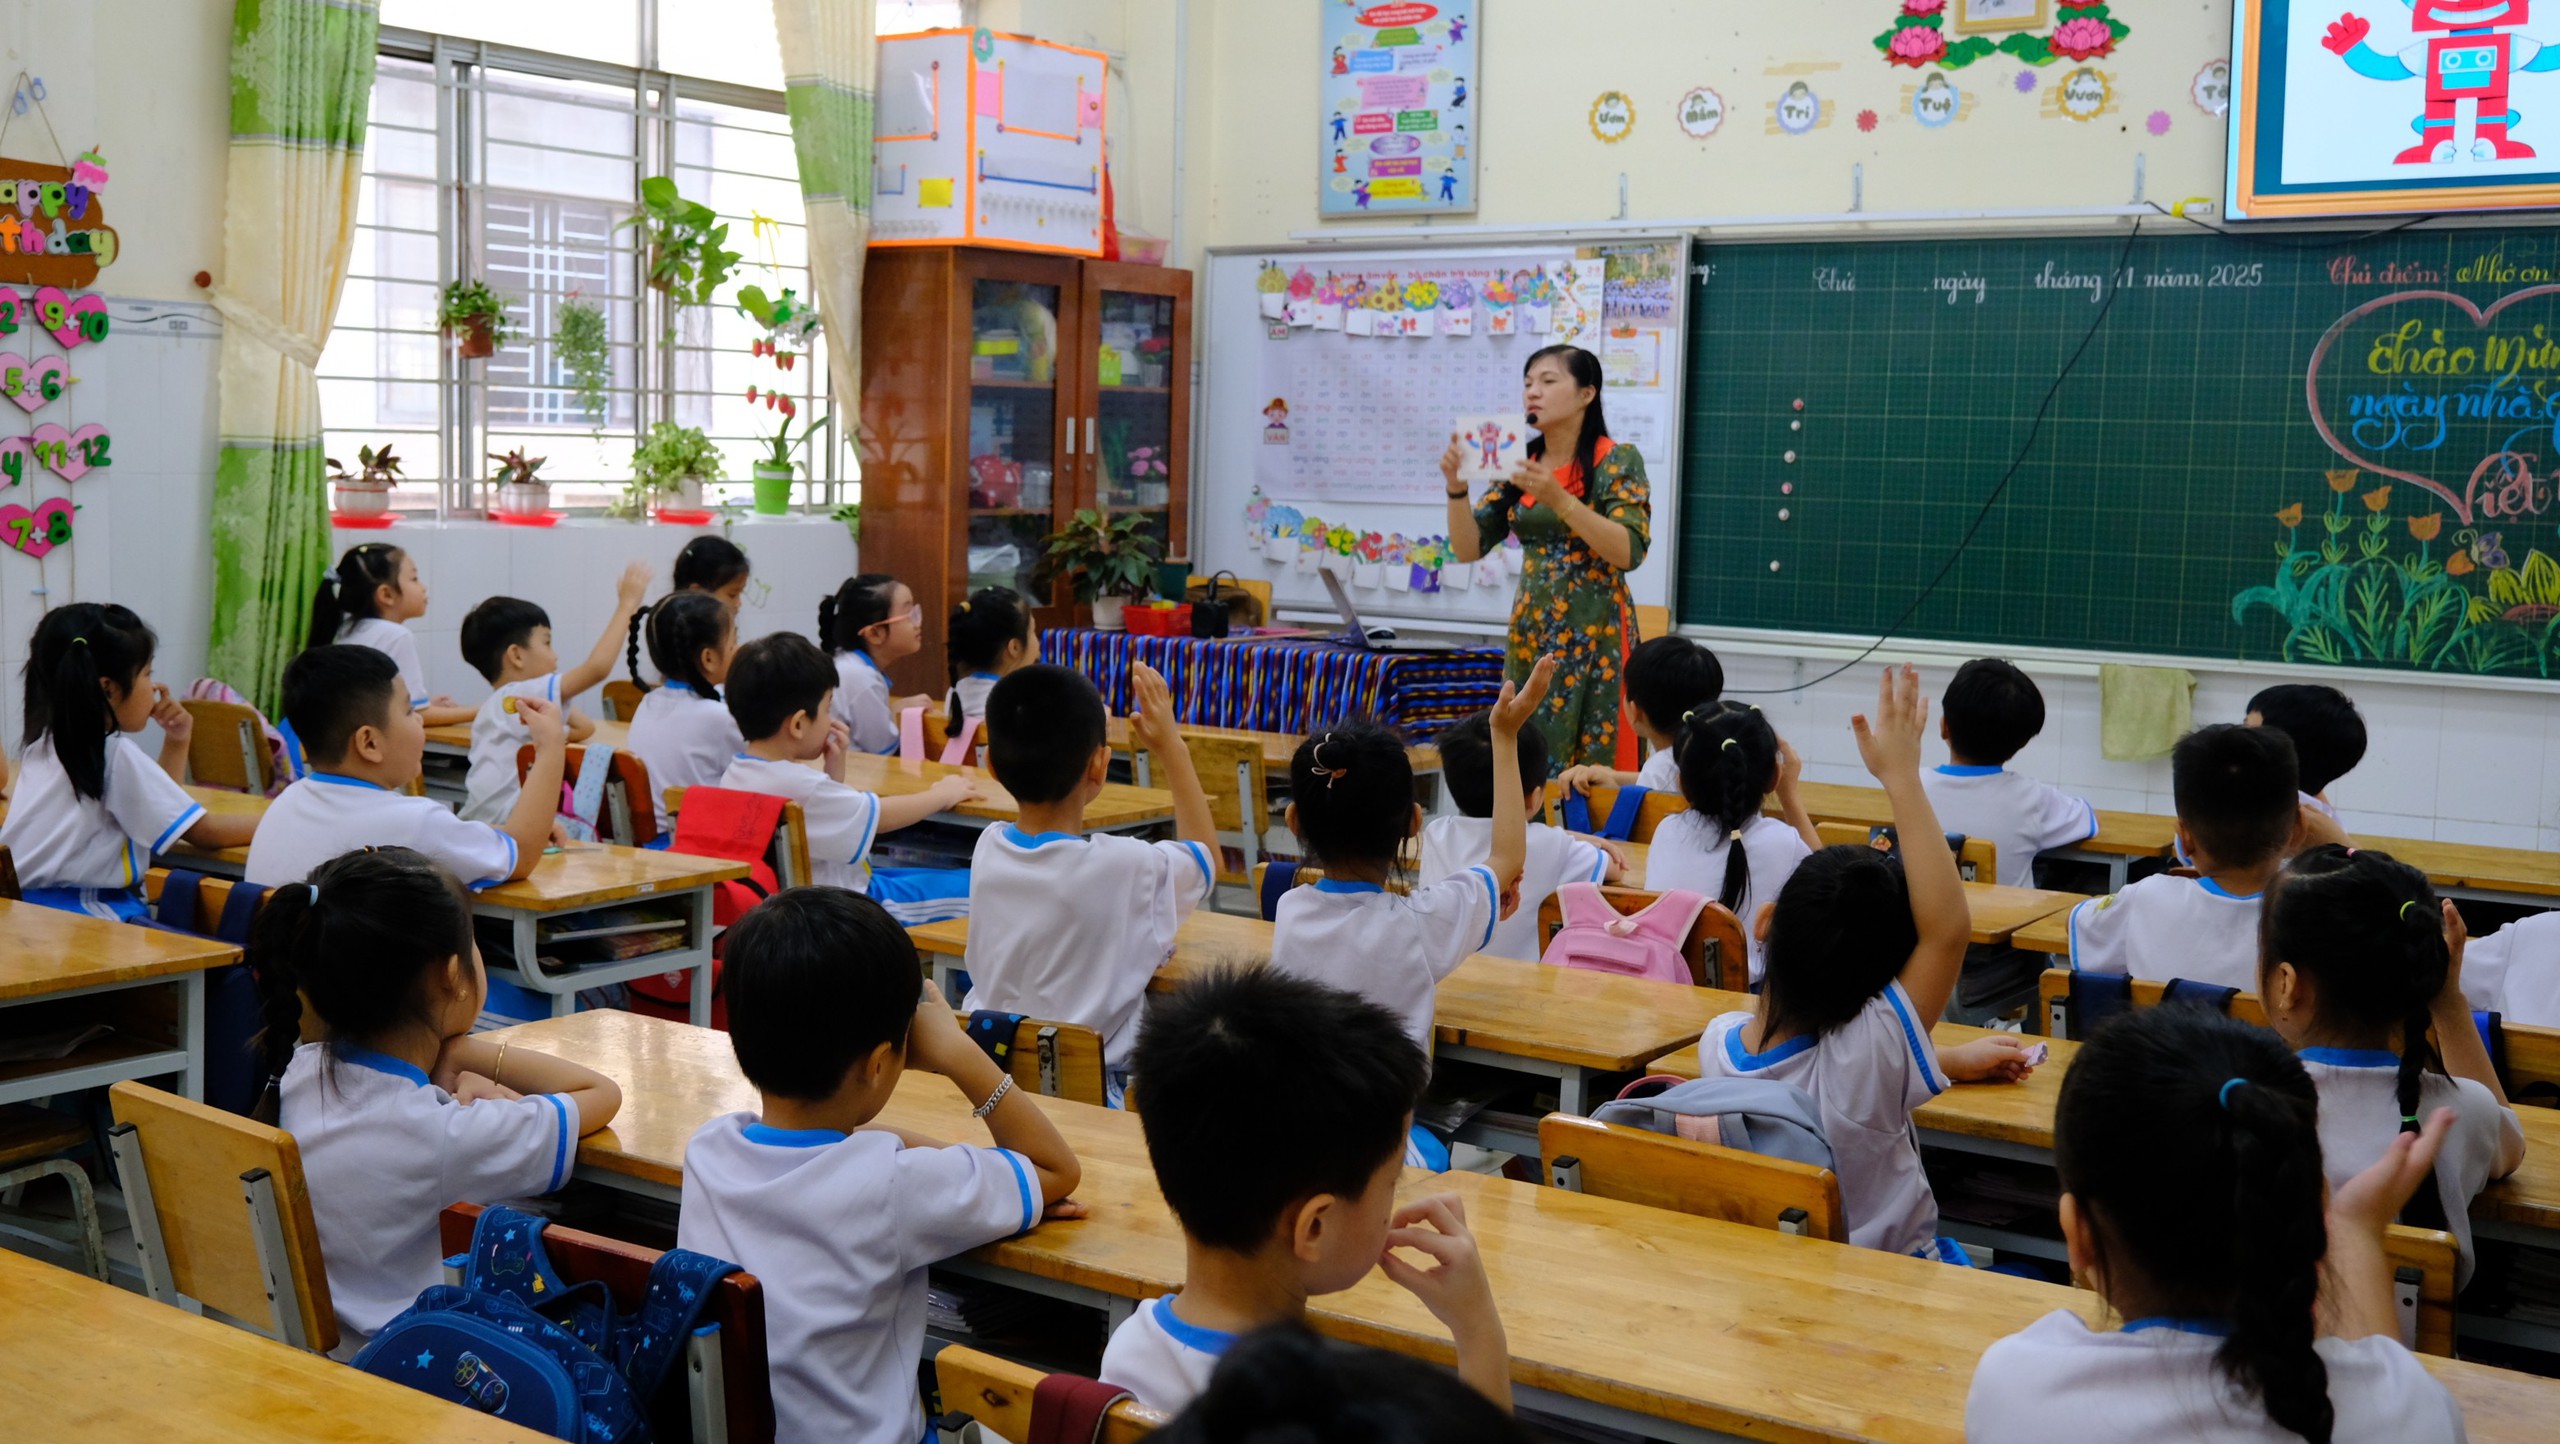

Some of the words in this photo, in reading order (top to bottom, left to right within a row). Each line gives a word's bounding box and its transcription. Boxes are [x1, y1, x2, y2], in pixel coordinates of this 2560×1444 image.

[1783, 105, 1810, 120] Trí
[1919, 98, 1952, 114] Tuệ
[0, 180, 89, 219] appy
[0, 217, 116, 267] thday
[1933, 271, 1986, 305] ngày
[2034, 261, 2102, 304] tháng
[2113, 266, 2134, 288] 11
[2144, 267, 2201, 288] năm
[2207, 263, 2264, 288] 2025
[44, 301, 109, 343] 9+10
[2368, 319, 2475, 374] Chào
[4, 367, 61, 401] 5+6
[2349, 380, 2449, 450] ngày
[2453, 373, 2545, 419] nhà
[34, 434, 111, 470] 11+12
[9, 510, 72, 550] 7+8
